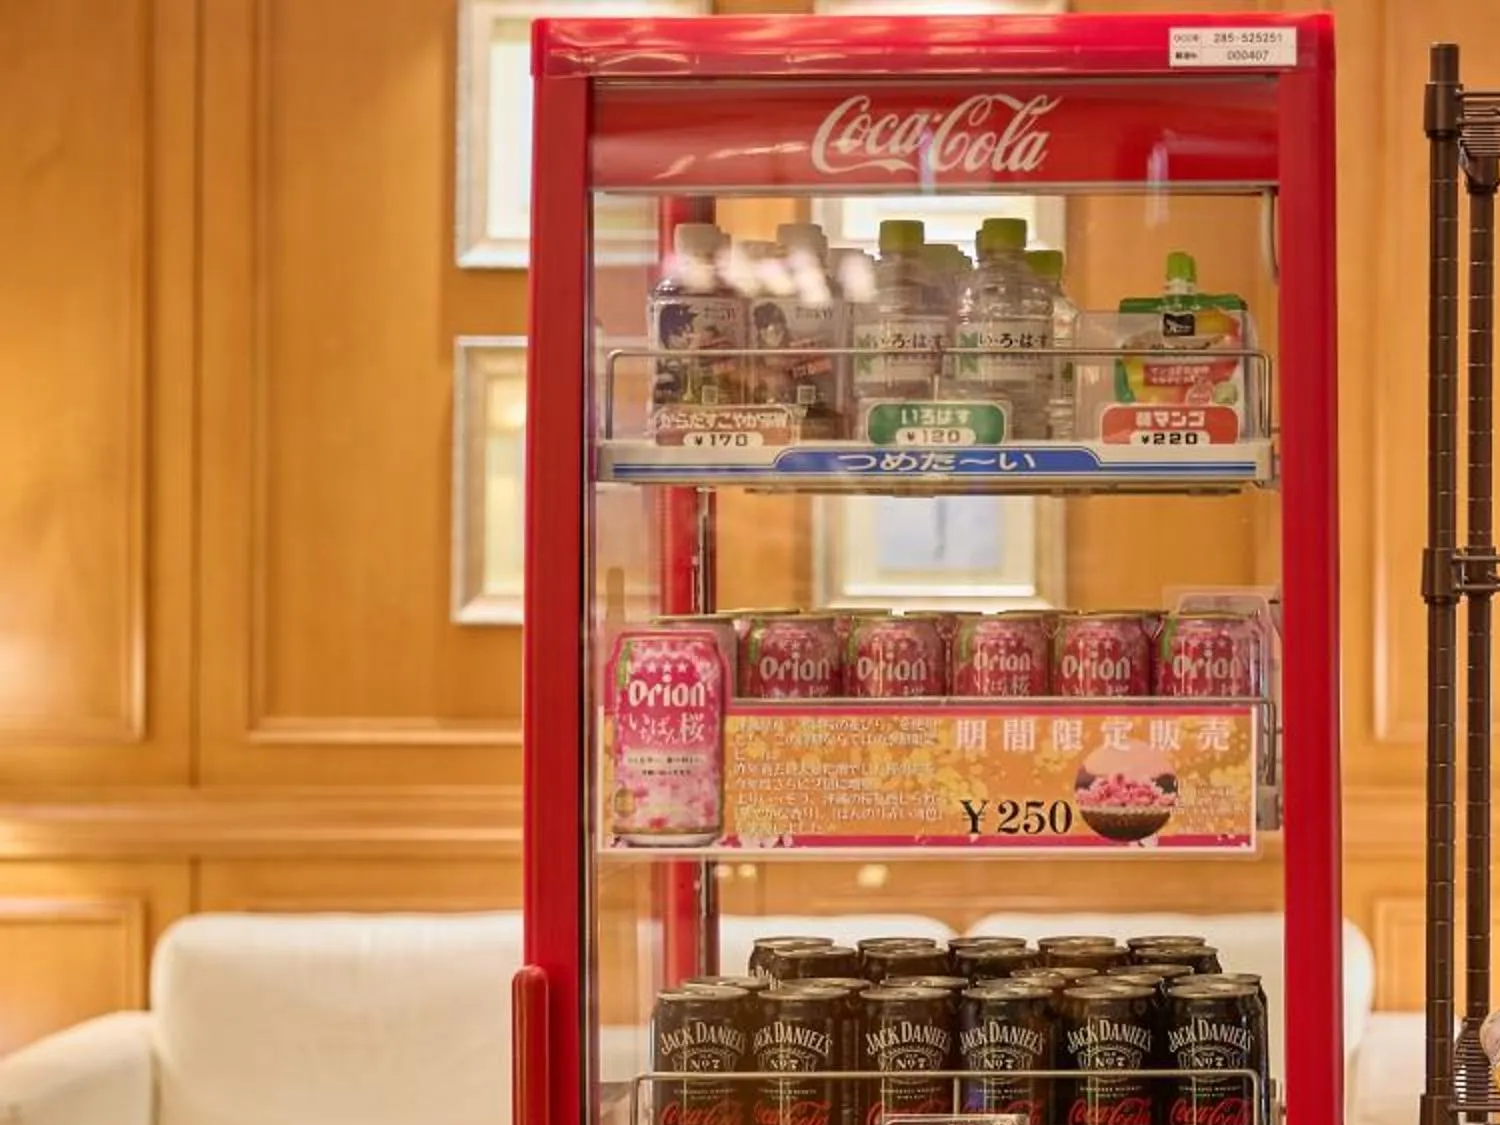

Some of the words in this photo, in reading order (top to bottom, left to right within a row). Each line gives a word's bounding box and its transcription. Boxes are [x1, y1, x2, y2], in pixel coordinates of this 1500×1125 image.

[811, 93, 1061, 174] Coca-Cola
[901, 408, 971, 425] いろはす
[907, 429, 960, 442] ¥120
[1141, 432, 1198, 445] ¥220
[759, 652, 831, 681] Orion
[856, 650, 926, 681] Orion
[974, 647, 1031, 671] Orion
[1061, 649, 1131, 681] Orion
[1173, 649, 1244, 680] Orion
[629, 674, 706, 707] Orion
[956, 718, 1231, 751] 期間限定販売
[960, 800, 1073, 834] ¥250
[661, 1027, 694, 1054] JACK
[865, 1026, 900, 1055] JACK
[1067, 1025, 1099, 1053] JACK
